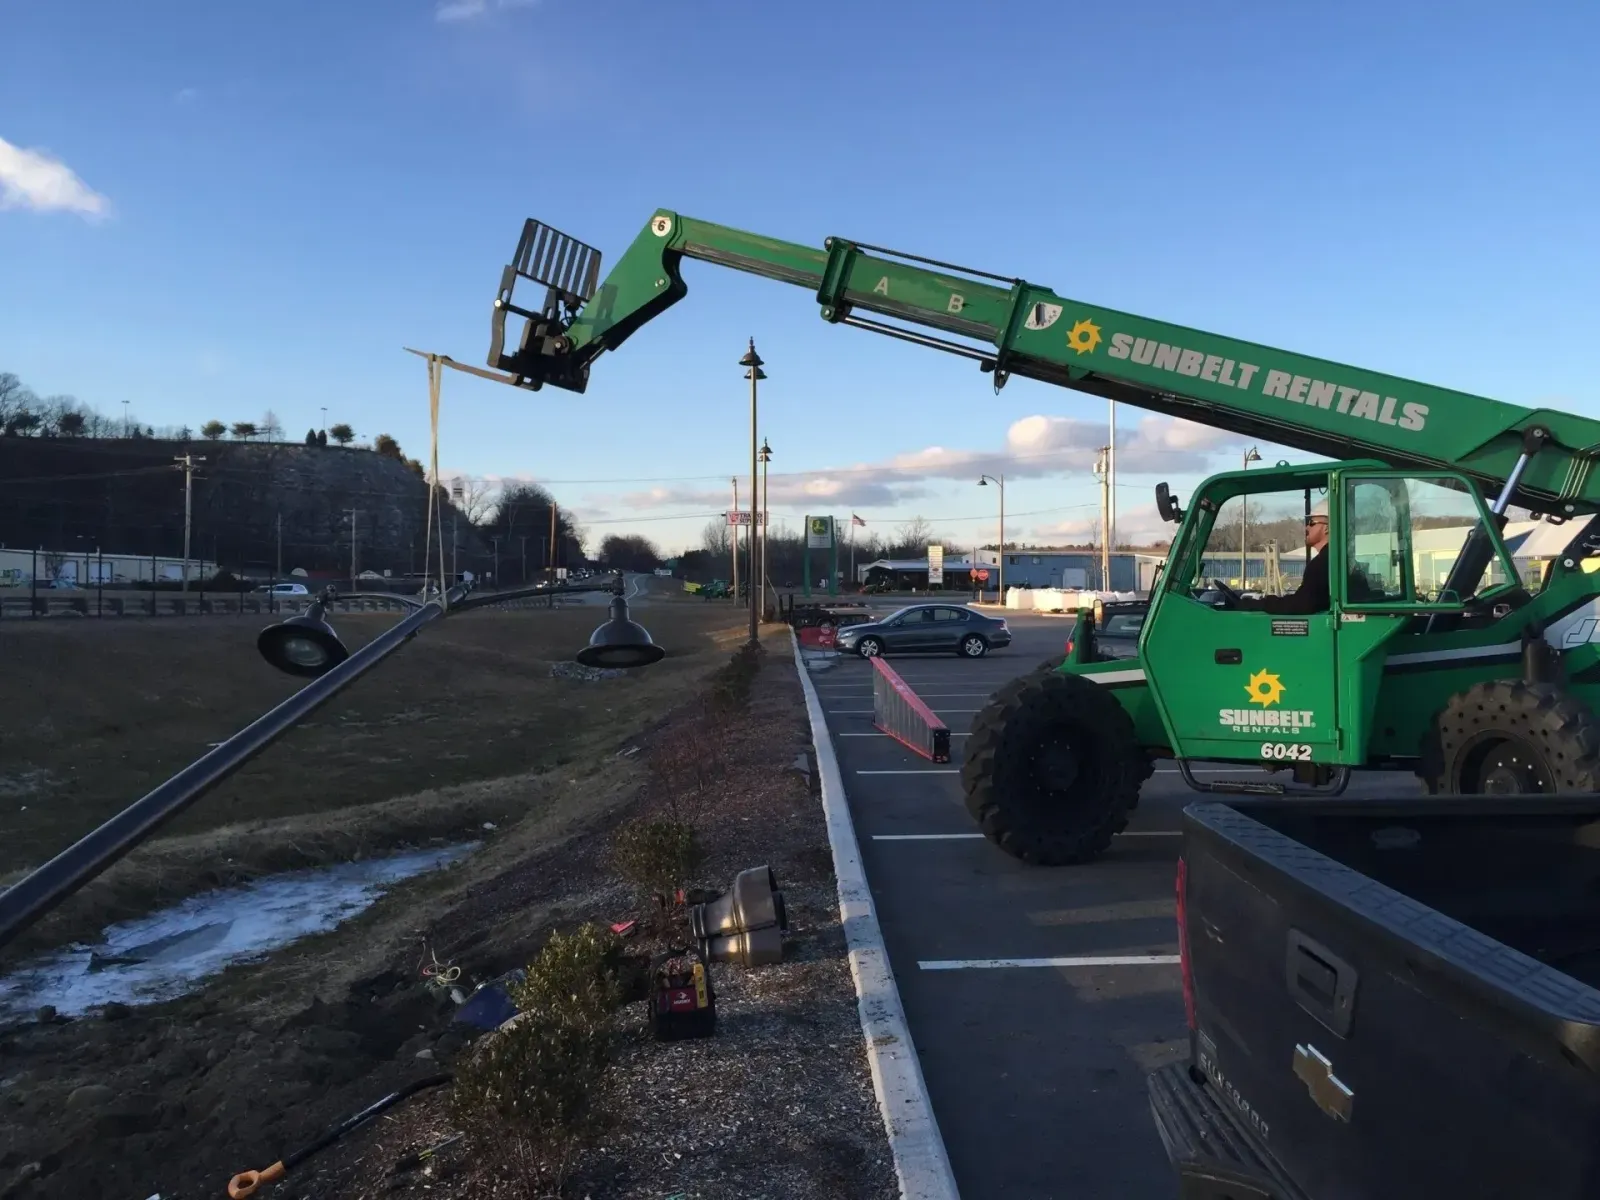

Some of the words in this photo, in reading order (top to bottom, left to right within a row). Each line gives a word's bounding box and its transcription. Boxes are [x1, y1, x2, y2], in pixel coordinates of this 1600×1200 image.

[657, 219, 666, 232] 6
[873, 276, 888, 296] A
[947, 293, 965, 313] B
[1107, 332, 1260, 390] SUNBELT
[1262, 368, 1430, 432] RENTALS
[1219, 708, 1314, 728] SUNBELT
[1232, 725, 1301, 735] RENTALS
[1260, 742, 1313, 761] 6042
[1200, 1052, 1269, 1139] SILVERADO
